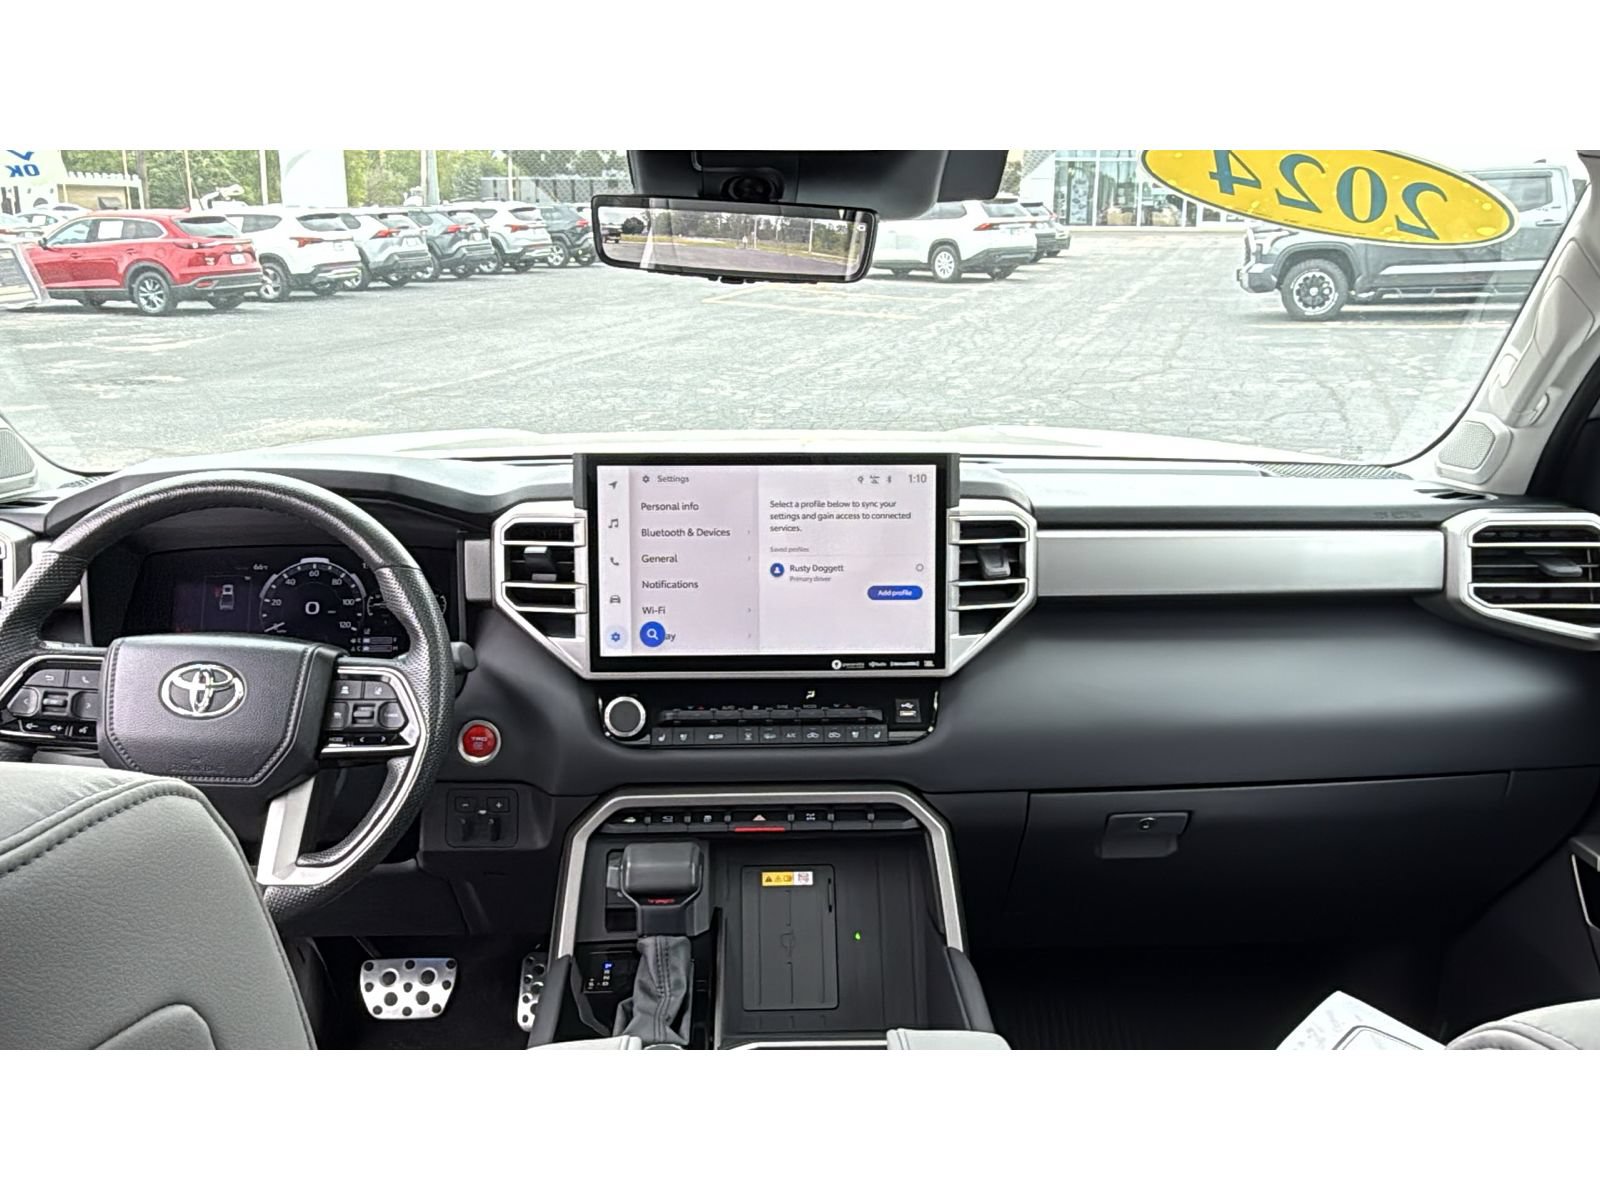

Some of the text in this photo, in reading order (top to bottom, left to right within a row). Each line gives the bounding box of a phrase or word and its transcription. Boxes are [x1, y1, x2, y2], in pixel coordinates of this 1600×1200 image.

[657, 474, 689, 484] Settings
[908, 473, 928, 484] 1:10
[640, 502, 700, 511] Personal info
[769, 500, 794, 509] Select
[800, 500, 826, 511] profile
[826, 500, 850, 509] below
[851, 501, 860, 509] to
[861, 502, 879, 511] sync
[879, 502, 897, 511] your
[769, 512, 912, 522] settings and gain access to connected
[641, 528, 731, 538] Bluetooth & Devices
[769, 524, 803, 533] services.
[641, 554, 678, 564] General
[308, 570, 320, 578] 60
[789, 564, 844, 574] Rusty Doggett
[284, 578, 297, 587] 40
[331, 578, 343, 586] 80
[641, 580, 699, 590] Notifications
[878, 589, 913, 599] Add profile
[271, 598, 283, 607] 20
[342, 598, 355, 607] 100
[304, 600, 321, 616] 0
[642, 606, 666, 615] Wi-Fi
[338, 620, 352, 629] 120
